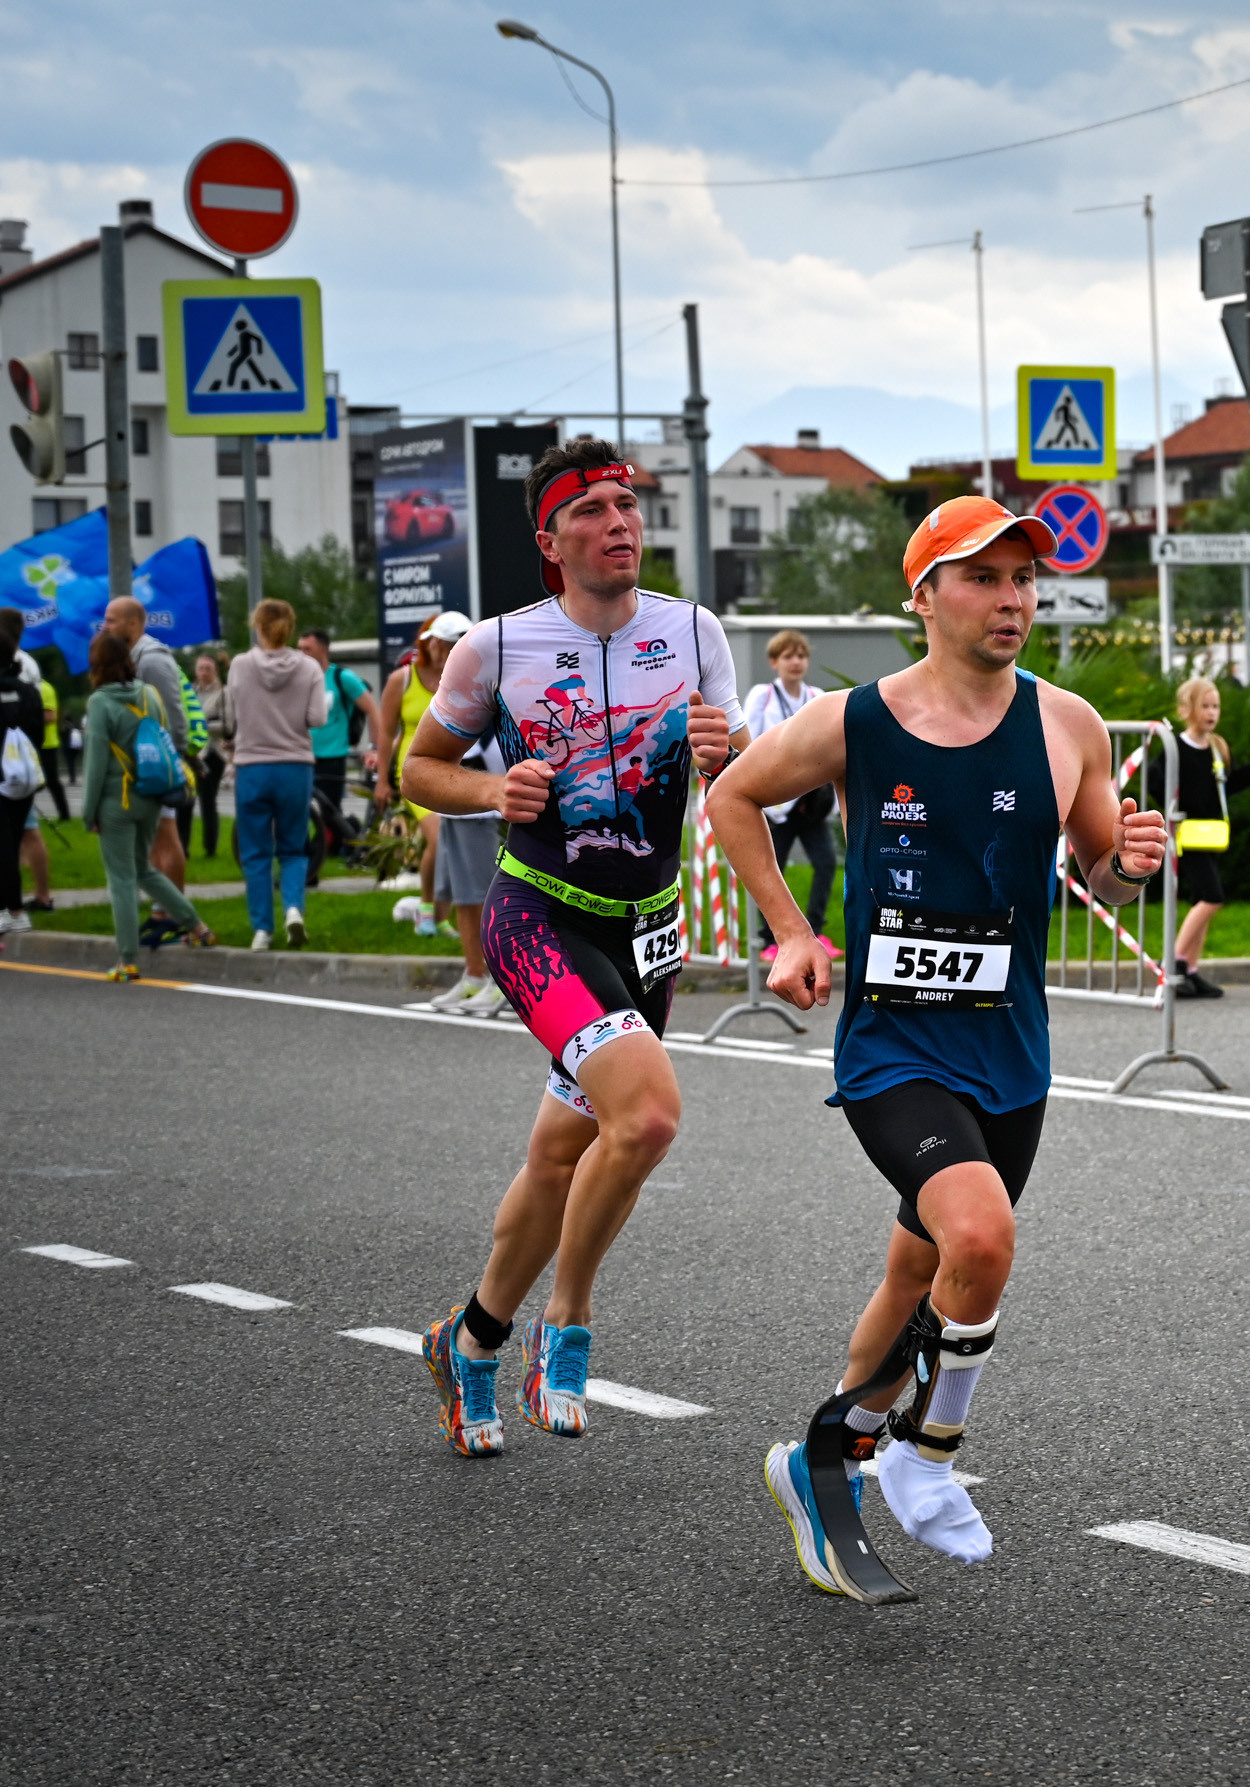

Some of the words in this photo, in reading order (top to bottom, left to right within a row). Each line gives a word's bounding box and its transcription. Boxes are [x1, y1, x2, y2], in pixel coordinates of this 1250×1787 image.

[392, 564, 430, 584] МИРОМ
[384, 586, 435, 606] ФОРМУЛЫ
[631, 652, 677, 667] Преодолей
[883, 801, 925, 812] ИНТЕР
[879, 847, 927, 856] ОРТО-СПОРТ
[881, 908, 897, 917] IRON
[634, 920, 648, 932] STAR
[879, 916, 903, 929] STAR
[643, 928, 682, 965] 429
[894, 946, 984, 983] 5547
[915, 990, 954, 1002] ANDREY
